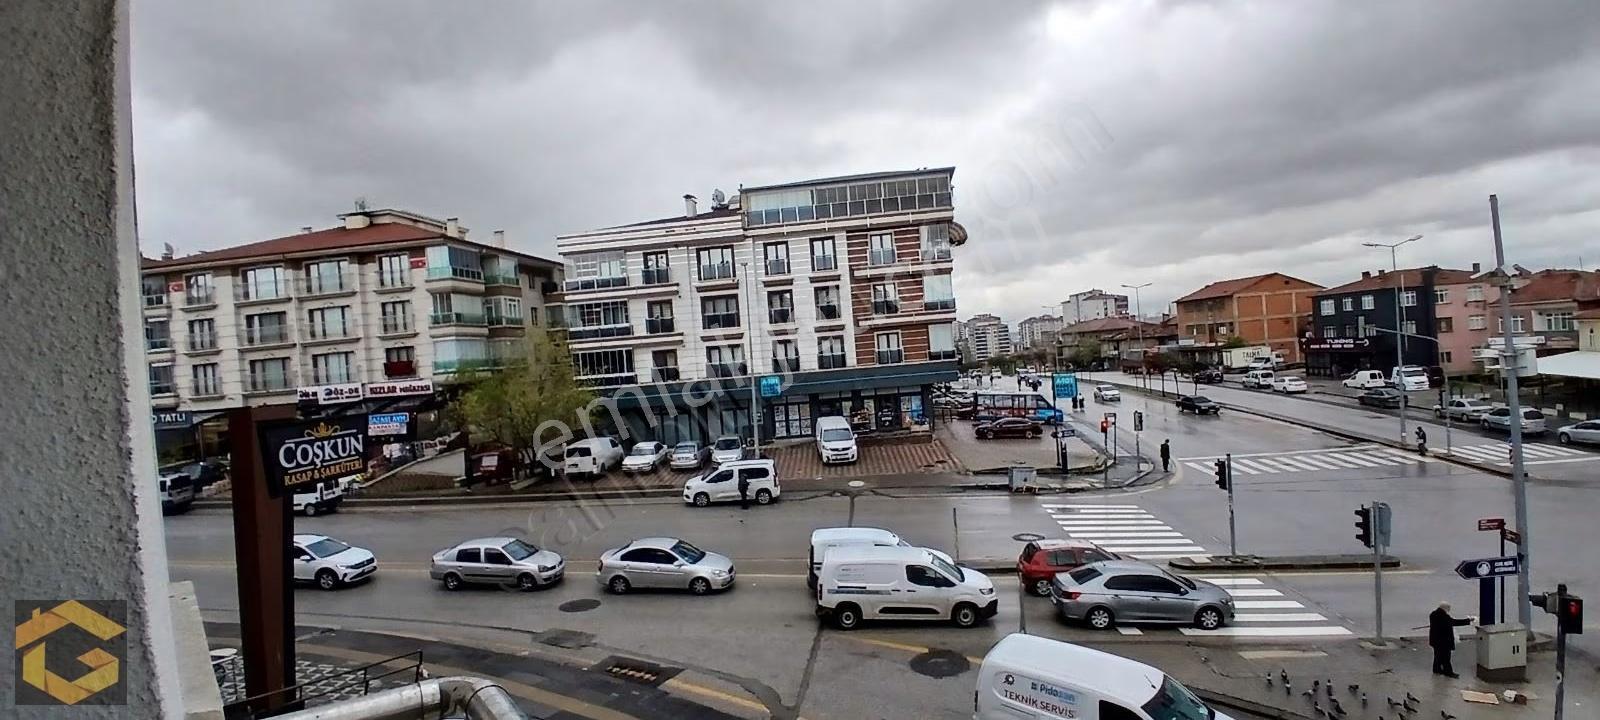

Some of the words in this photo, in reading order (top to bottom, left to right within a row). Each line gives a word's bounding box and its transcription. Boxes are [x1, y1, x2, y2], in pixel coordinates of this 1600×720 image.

[160, 413, 186, 423] TATLI
[278, 434, 364, 469] COŞKUN
[284, 472, 313, 486] KASAP
[313, 470, 320, 479] &
[320, 460, 363, 478] ŞARKÜTERİ
[1004, 689, 1038, 707] TEKNİK
[1039, 700, 1075, 719] SERVİS
